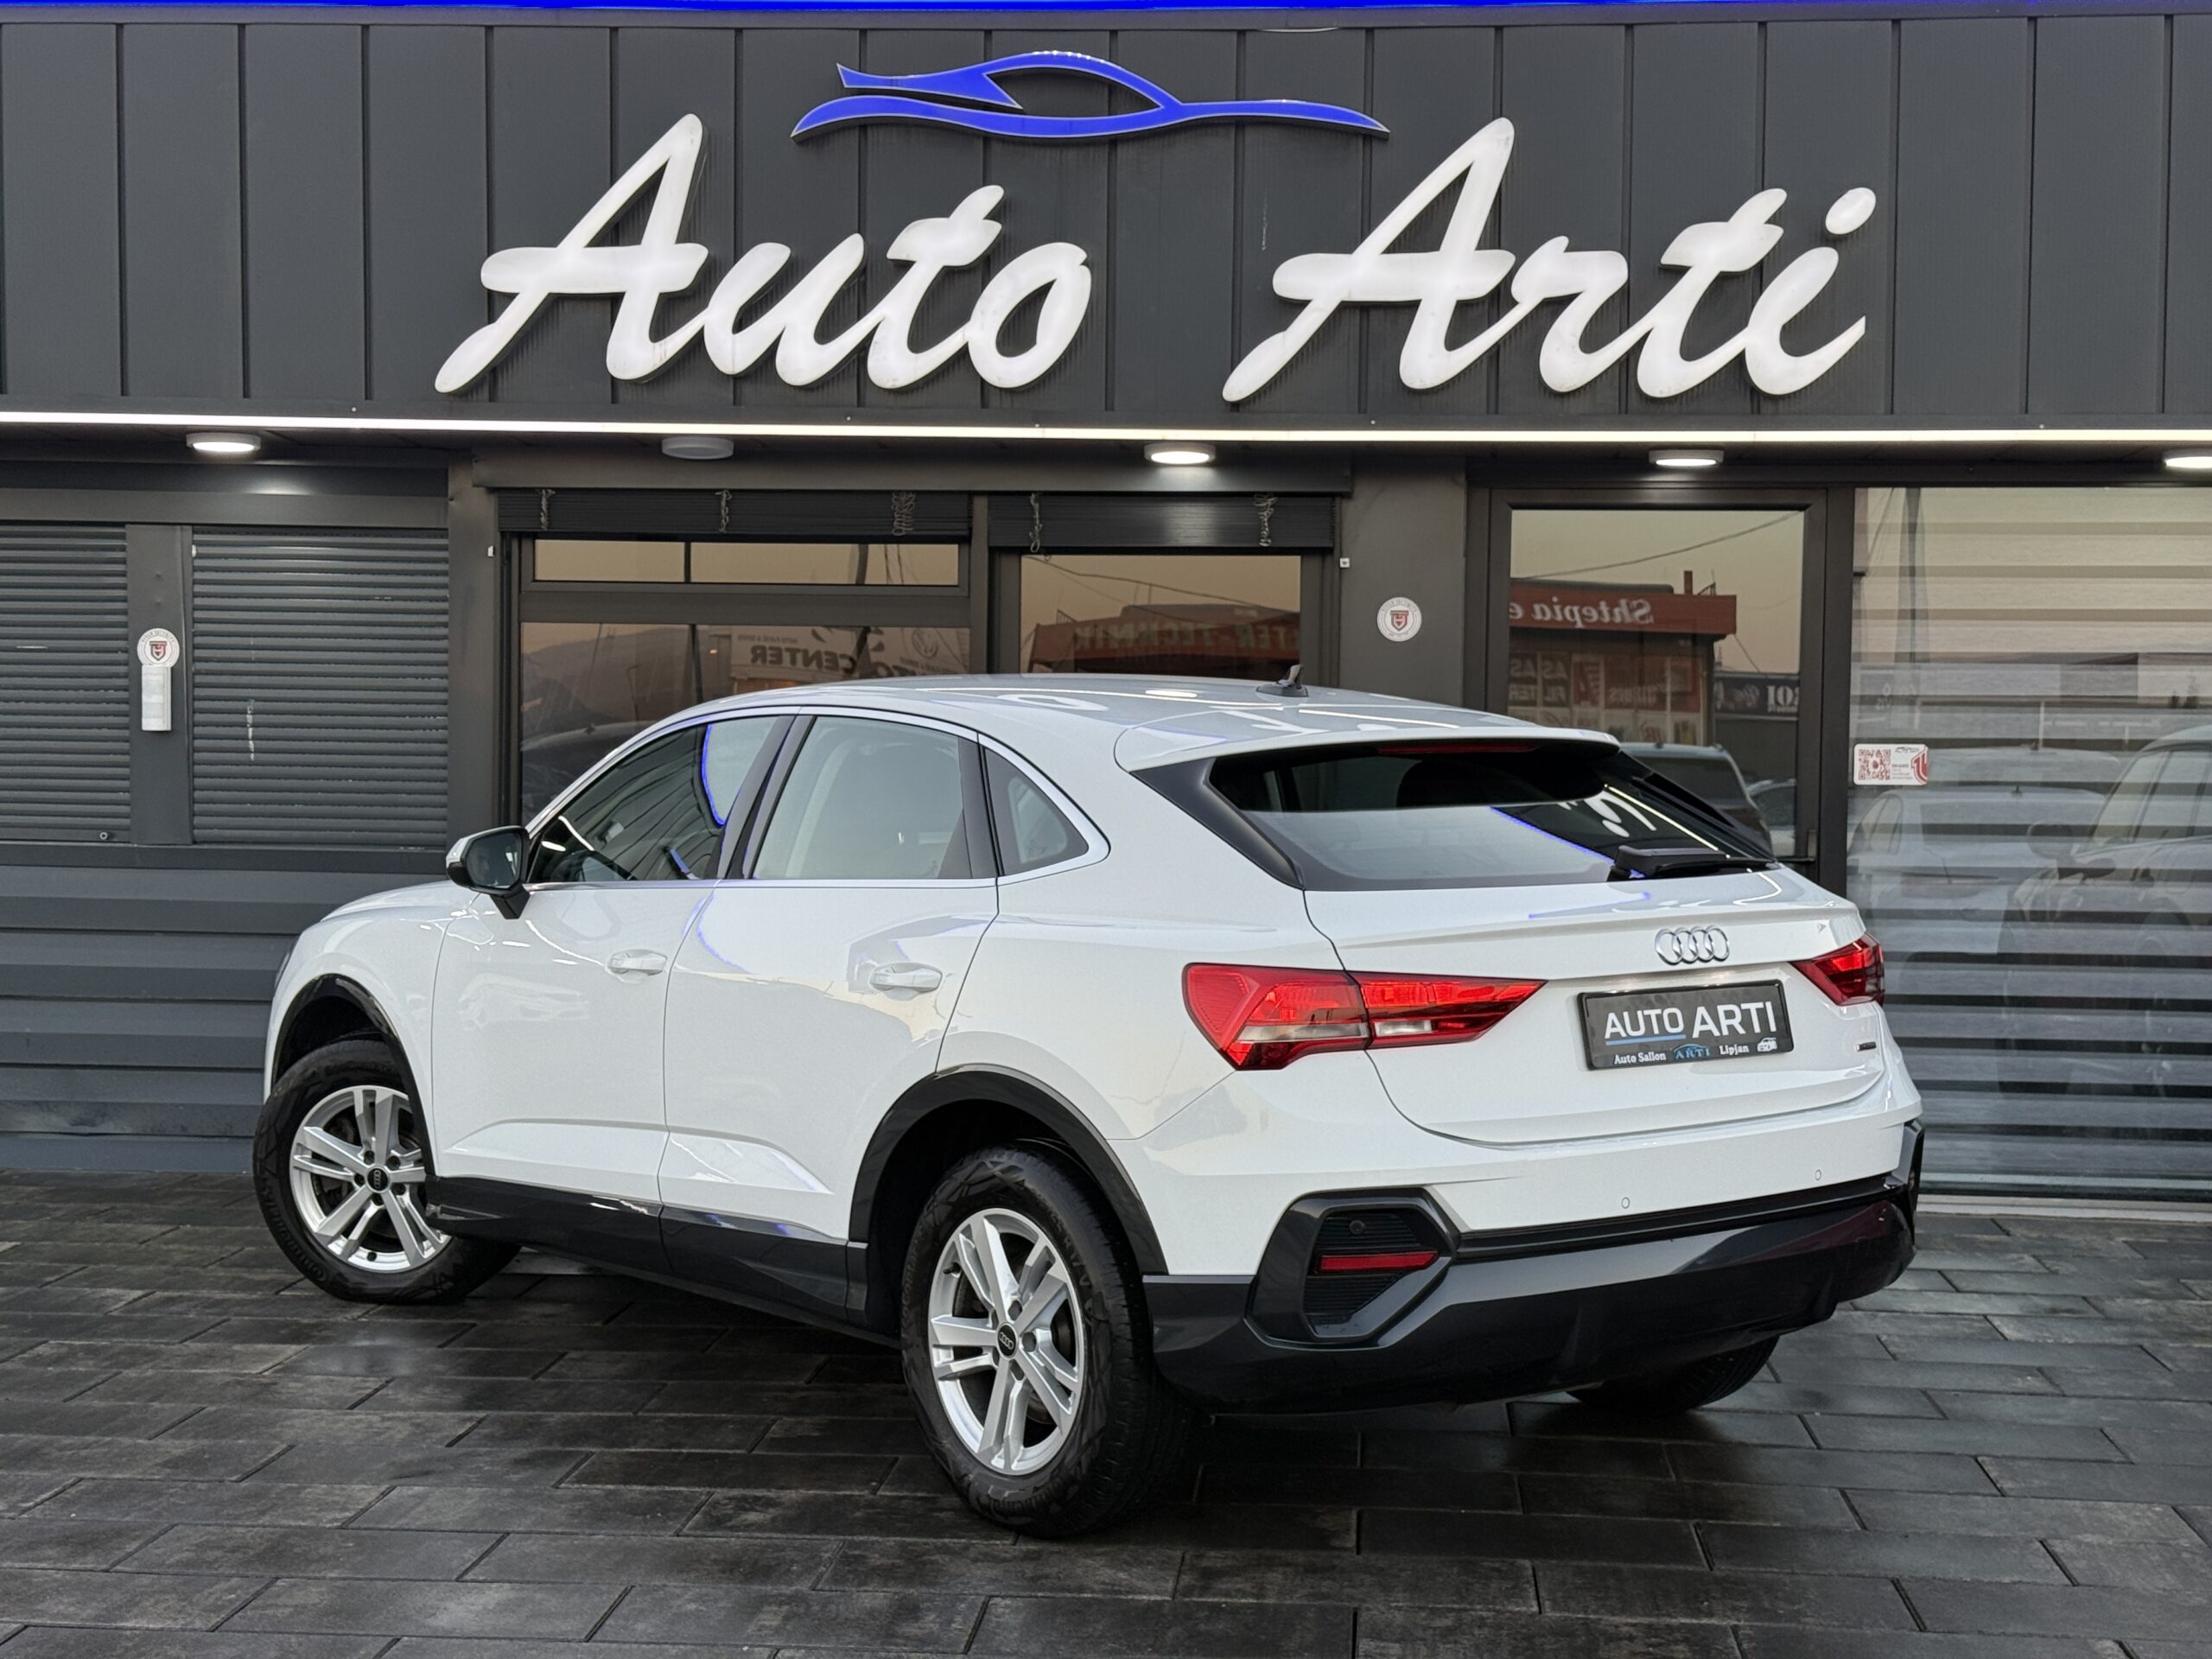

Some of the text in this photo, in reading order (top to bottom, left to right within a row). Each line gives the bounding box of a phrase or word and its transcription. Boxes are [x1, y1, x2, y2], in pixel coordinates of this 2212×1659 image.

[434, 113, 1876, 401] Auto Arti
[1605, 1001, 1777, 1039] AUTO ARTI
[1613, 1053, 1637, 1065] Auto
[1674, 1046, 1711, 1060] ARTI
[1719, 1044, 1750, 1056] Lipjan
